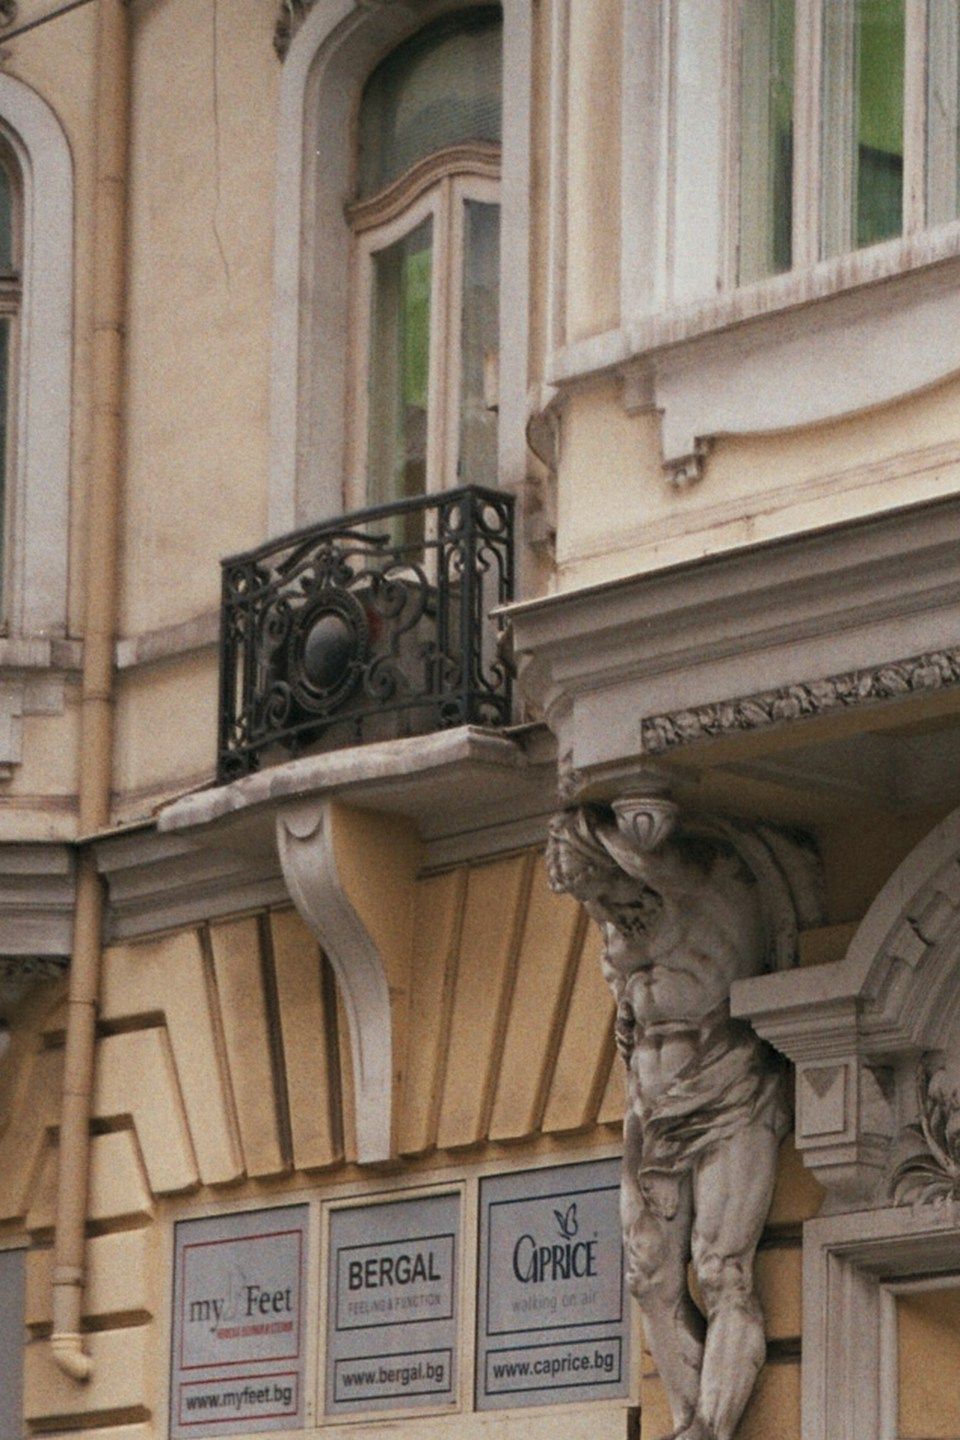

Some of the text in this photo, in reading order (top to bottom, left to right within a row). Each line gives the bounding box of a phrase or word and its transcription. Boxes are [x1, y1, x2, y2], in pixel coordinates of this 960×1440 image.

[348, 1252, 442, 1291] BERGAL
[189, 1298, 224, 1333] my
[244, 1285, 293, 1317] Feet
[342, 1362, 445, 1386] www.bergal.bg
[493, 1350, 615, 1379] www.caprice.bg
[186, 1384, 293, 1411] www.myfeet.bg
